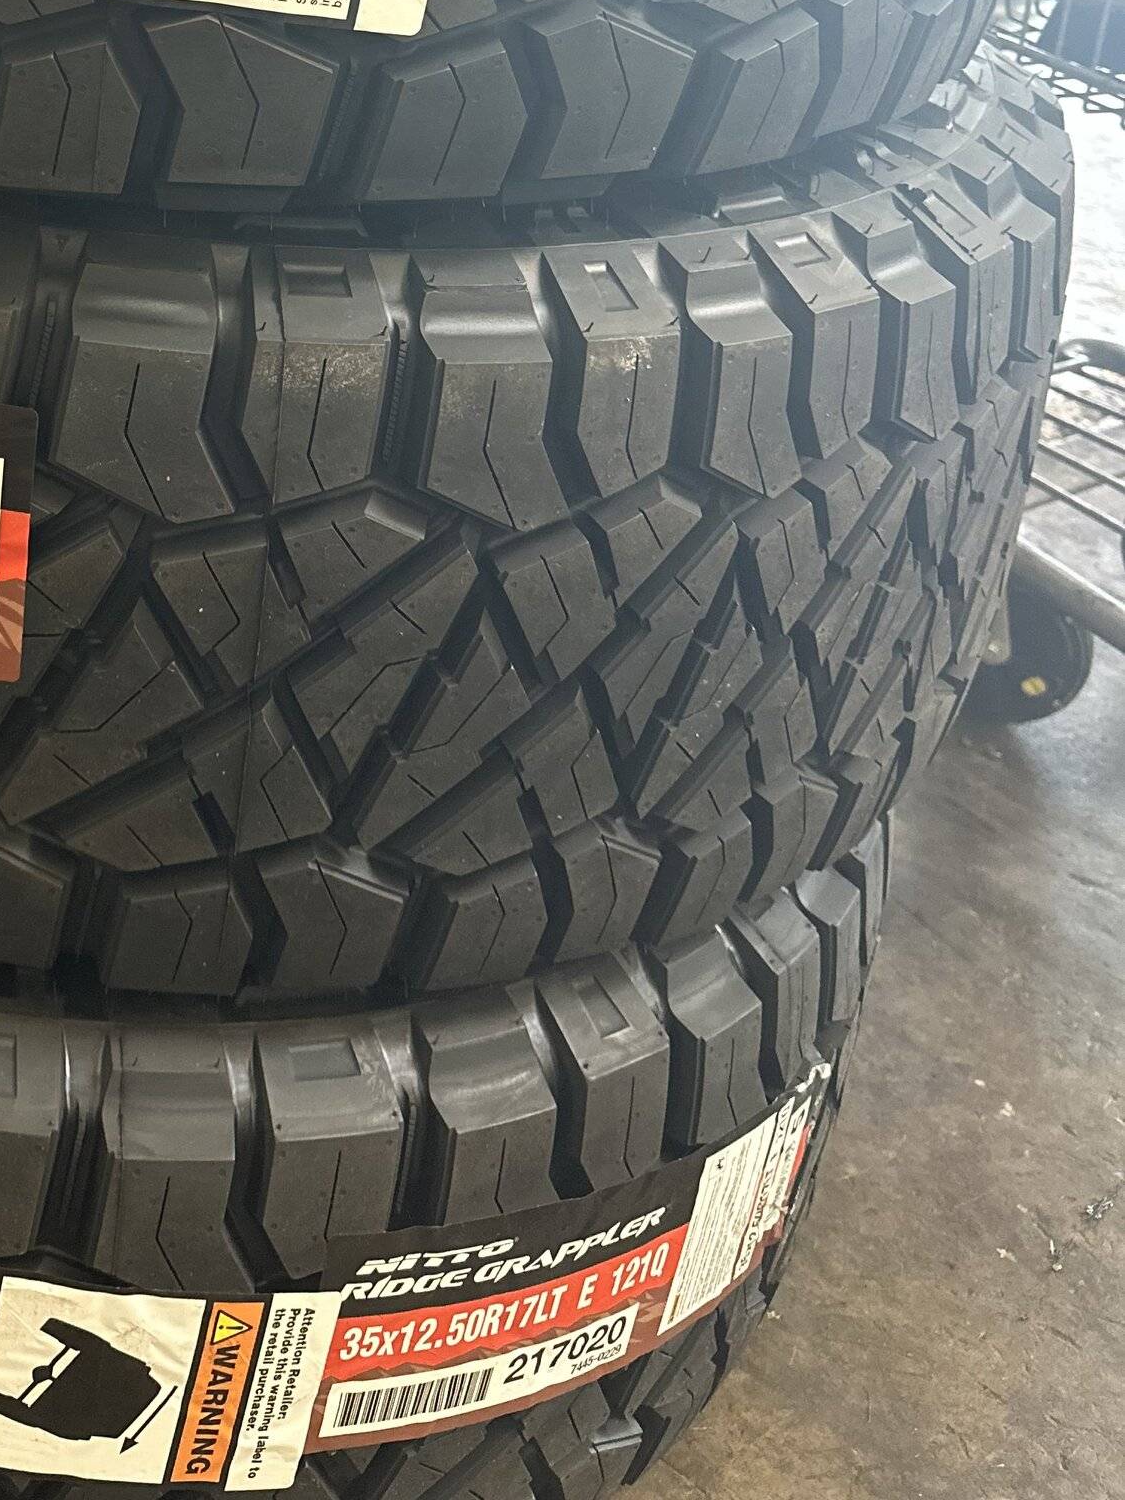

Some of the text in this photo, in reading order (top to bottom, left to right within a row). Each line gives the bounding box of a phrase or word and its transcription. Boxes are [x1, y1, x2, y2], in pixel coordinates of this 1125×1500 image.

[339, 1242, 670, 1361] 35x12.50R17LT E 121Q
[340, 1207, 666, 1302] RIDGE GRAPPLER
[356, 1238, 515, 1276] NITTO
[243, 1308, 287, 1431] the retail purchaser.
[247, 1308, 301, 1478] Provide this warning label to
[277, 1307, 315, 1419] Attention Retailer:
[504, 1316, 627, 1385] 217020
[571, 1344, 622, 1375] 7445-0229
[185, 1344, 240, 1475] WARNING
